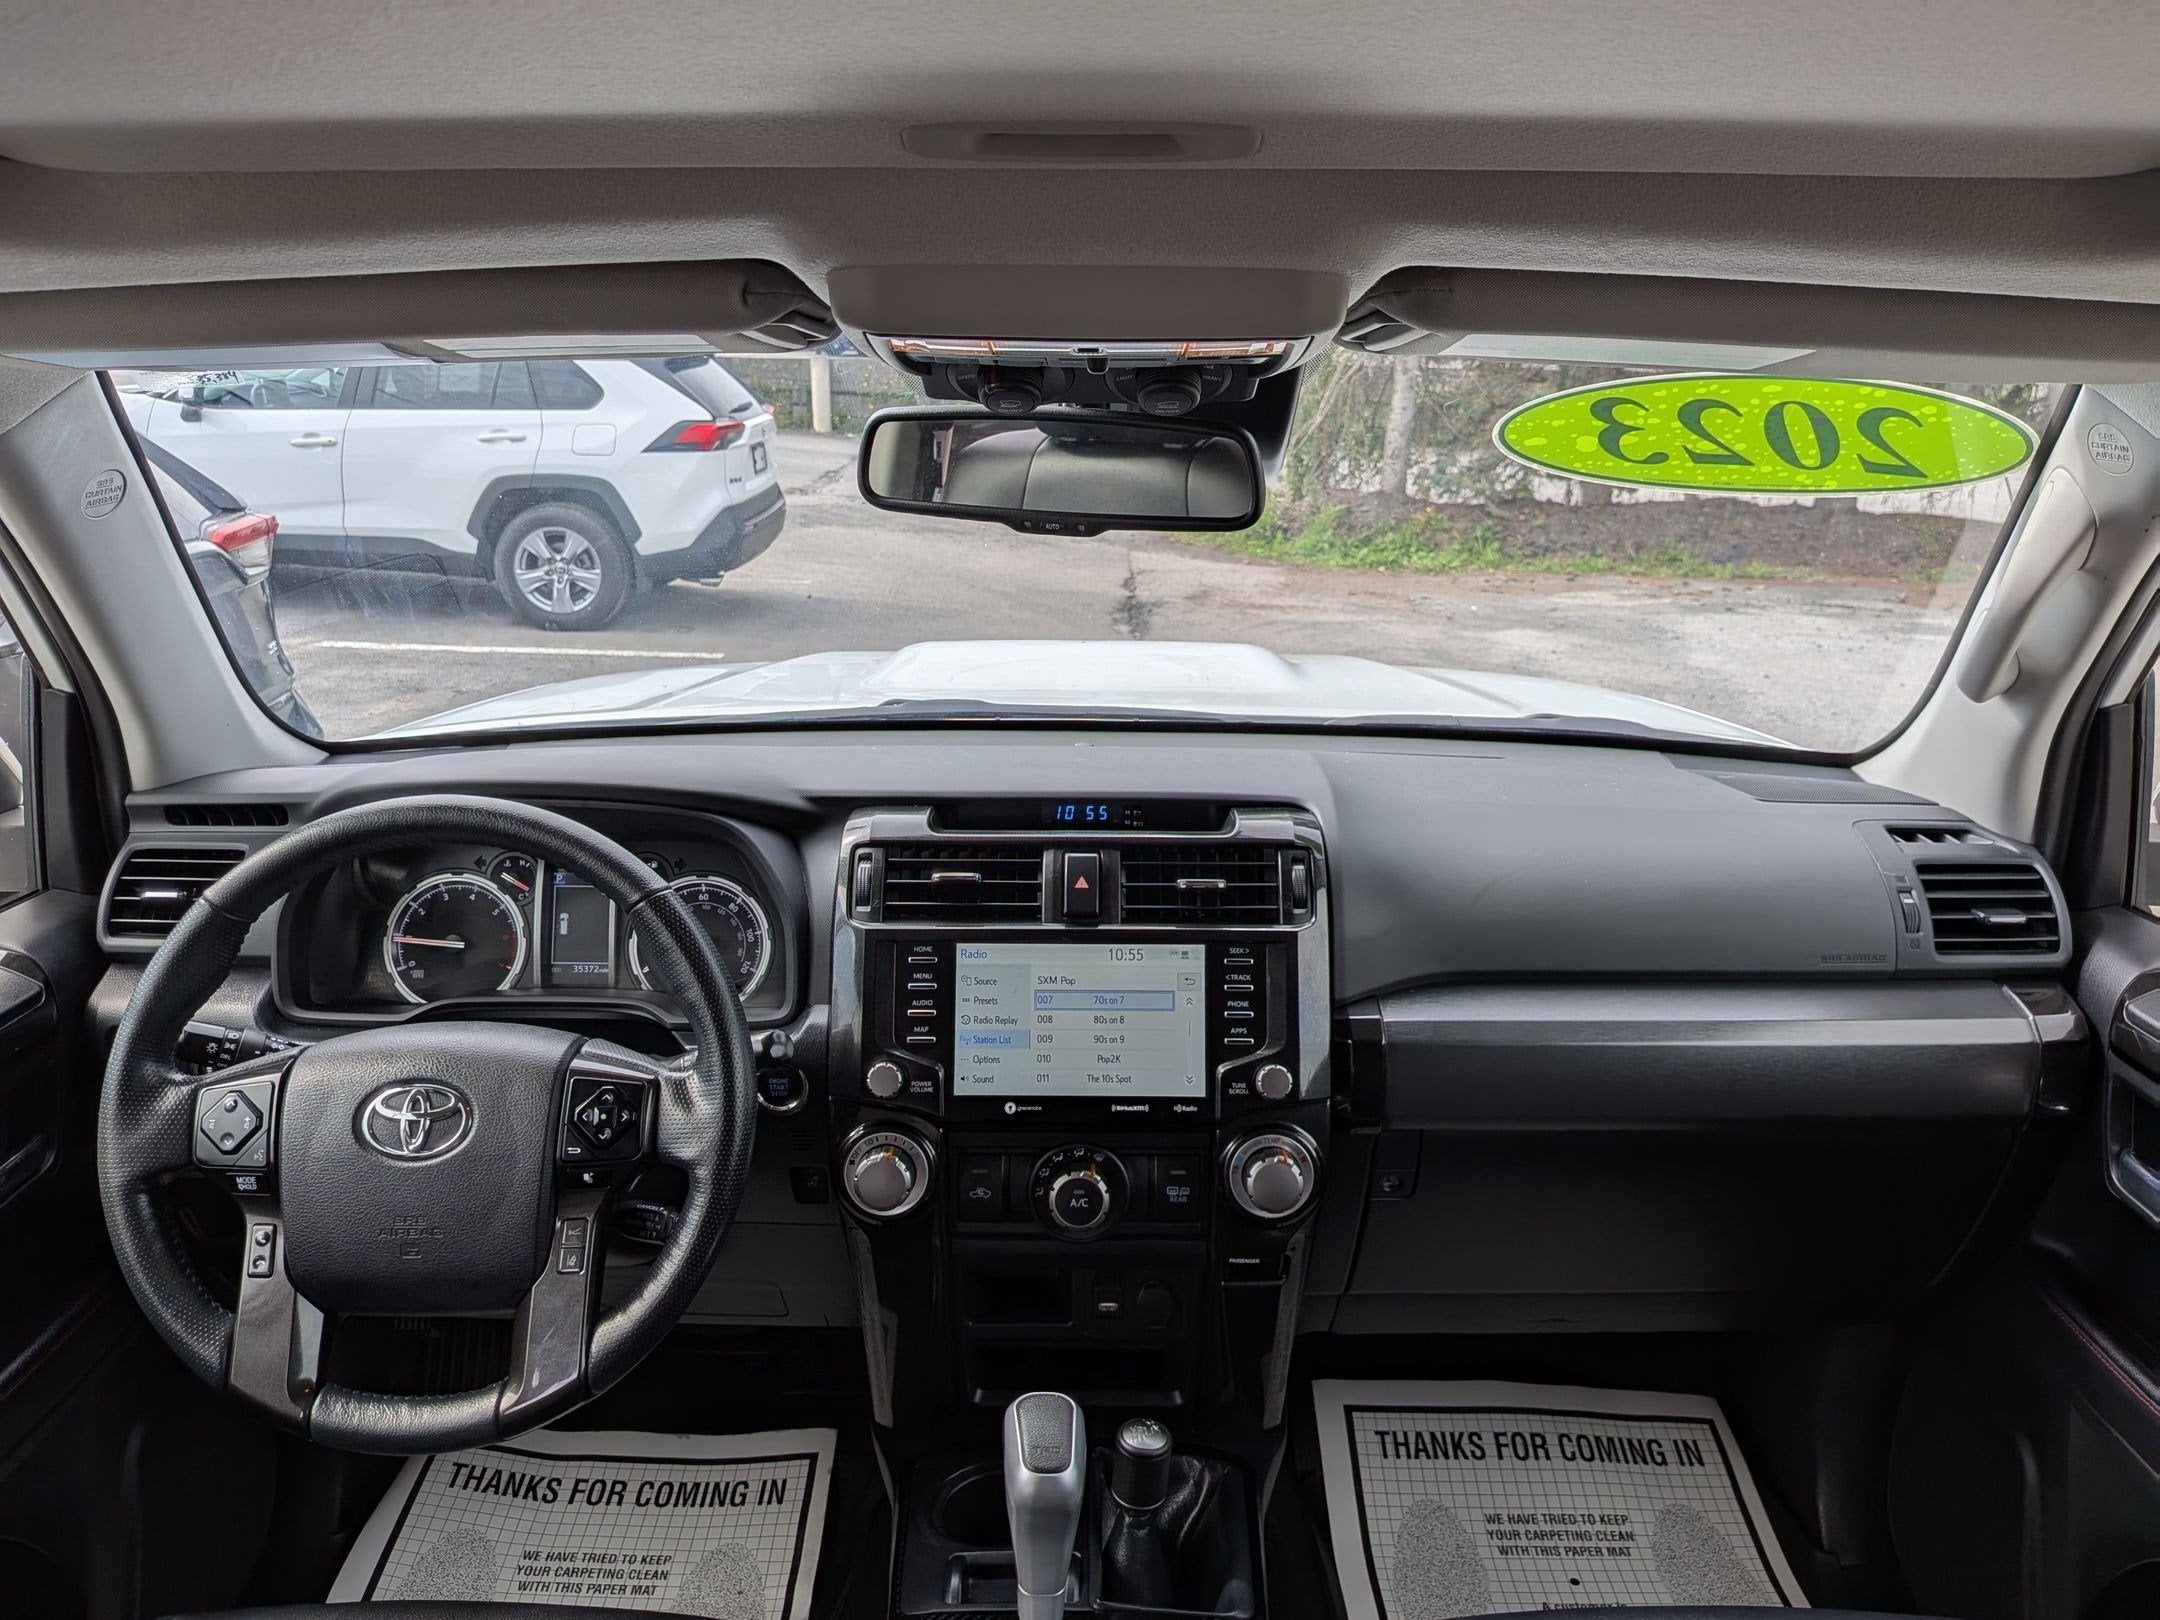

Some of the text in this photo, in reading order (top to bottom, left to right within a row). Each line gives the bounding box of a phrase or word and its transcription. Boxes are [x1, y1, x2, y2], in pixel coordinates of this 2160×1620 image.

[2091, 441, 2129, 453] CURTAIN
[2095, 451, 2130, 462] AIRBAG
[85, 485, 122, 499] CURTAIN
[85, 494, 119, 508] AIRBAG
[442, 893, 449, 901] 3
[418, 908, 426, 916] 2
[728, 902, 739, 913] 80
[745, 928, 755, 943] 100
[960, 949, 988, 959] Radio
[1109, 948, 1144, 961] 10:55
[408, 960, 416, 968] 0
[573, 965, 600, 973] 35372
[740, 960, 751, 975] 120
[974, 977, 997, 986] Source
[1037, 976, 1076, 987] SXM Pop
[973, 996, 998, 1005] Presets
[1037, 996, 1053, 1004] 007
[1094, 996, 1108, 1004] 70s
[1120, 996, 1125, 1004] 7
[973, 1016, 1018, 1026] Radio Replay
[1037, 1015, 1053, 1024] 008
[1093, 1016, 1107, 1024] 80s
[1119, 1016, 1125, 1024] 8
[973, 1035, 1012, 1044] Station List
[1037, 1035, 1053, 1044] 009
[1093, 1035, 1107, 1044] 90s
[1119, 1035, 1125, 1044] 9
[973, 1054, 1000, 1064] Options
[1036, 1055, 1121, 1064] 010 Pop2K
[972, 1074, 995, 1083] Sound
[1036, 1074, 1132, 1085] 011 The 10s Spot
[236, 1176, 257, 1184] MODE
[1070, 1198, 1089, 1208] A/C
[1169, 1195, 1188, 1203] REAR
[1374, 1430, 1705, 1467] THANKS FOR COMING IN
[448, 1462, 787, 1508] THANKS FOR COMING IN
[1485, 1513, 1628, 1526] WE HAVE TRIED TO KEEP
[1487, 1529, 1634, 1542] YOUR CARPETING CLEAN
[1497, 1546, 1631, 1557] WITH THIS PAPER MAT
[523, 1550, 672, 1566] WE HAVE TRIED TO KEEP
[516, 1564, 668, 1580] YOUR CARPETING CLEAN
[517, 1581, 658, 1596] WITH THIS PAPER MAT
